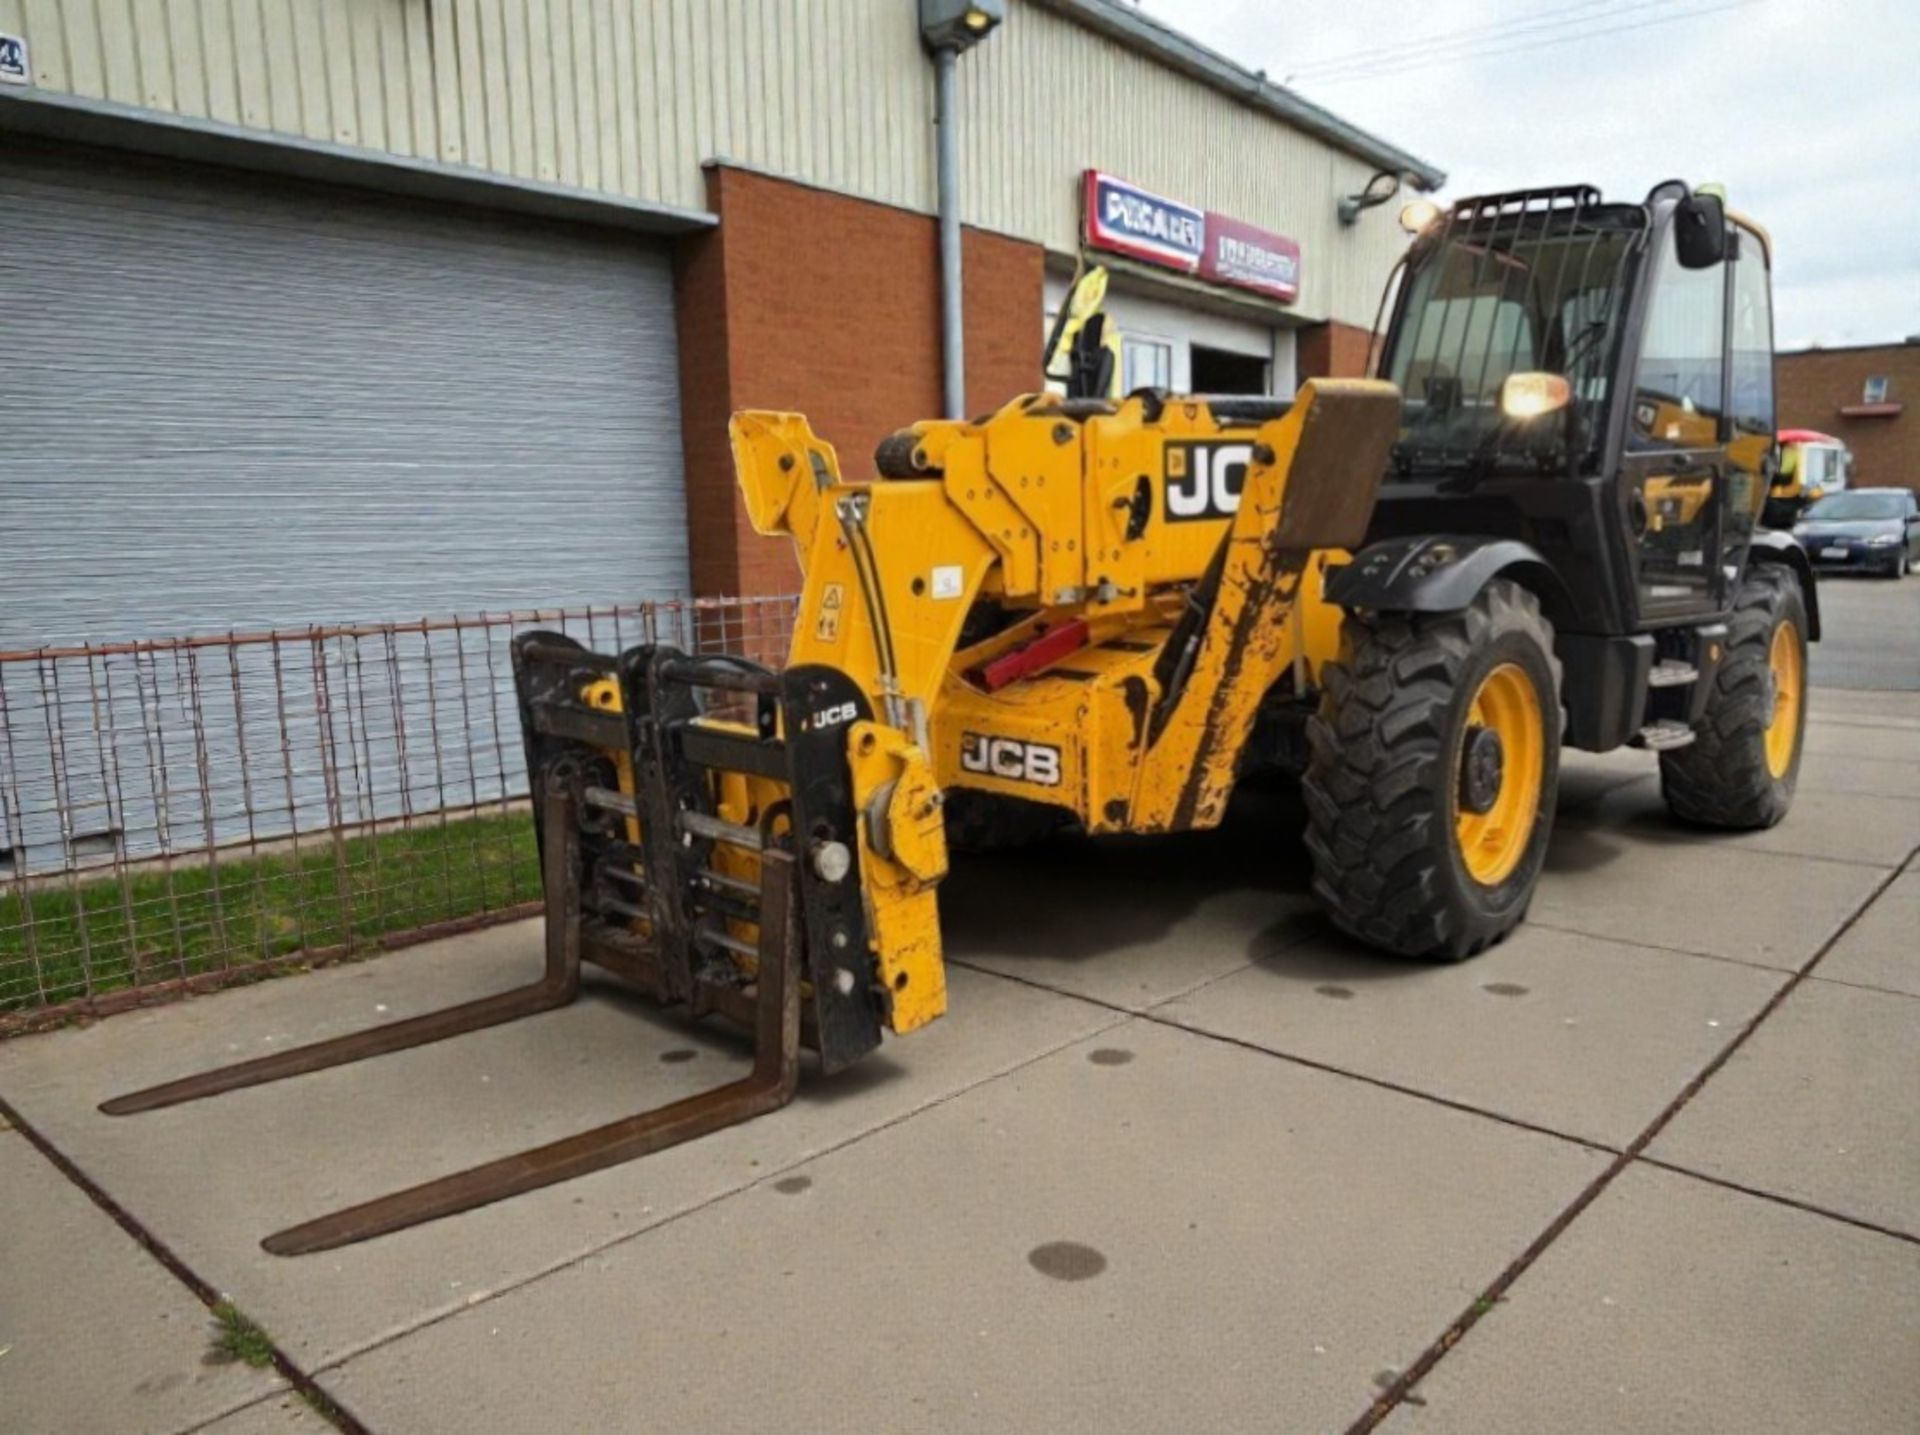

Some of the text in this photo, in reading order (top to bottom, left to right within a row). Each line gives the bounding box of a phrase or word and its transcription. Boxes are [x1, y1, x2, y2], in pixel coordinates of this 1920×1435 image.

[1167, 444, 1253, 516] JC
[813, 701, 858, 730] JCB
[962, 736, 1061, 785] JCB
